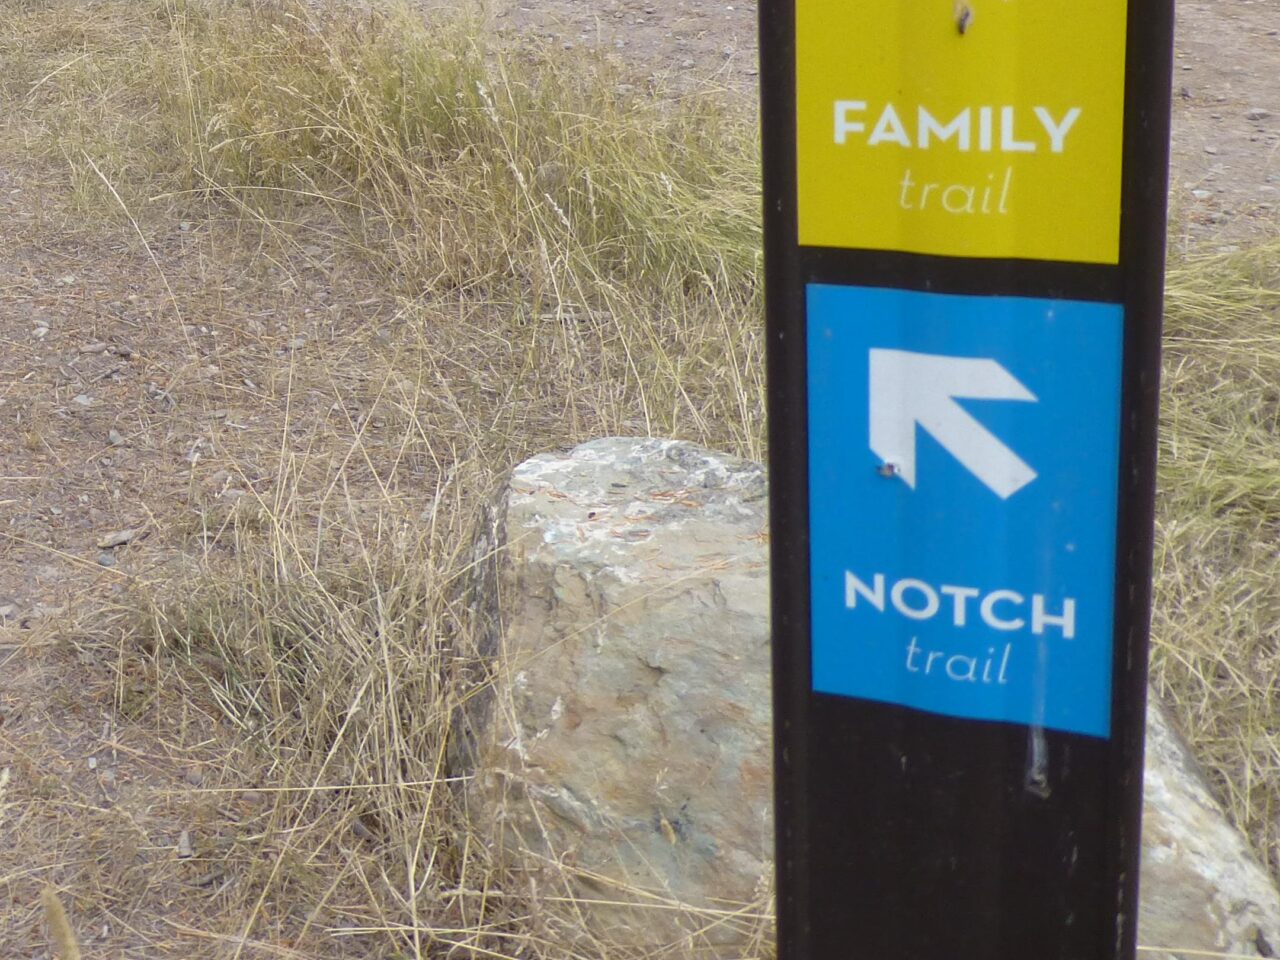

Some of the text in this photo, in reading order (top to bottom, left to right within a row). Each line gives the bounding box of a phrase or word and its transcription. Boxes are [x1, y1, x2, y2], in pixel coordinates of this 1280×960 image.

[833, 100, 1082, 153] FAMILY
[899, 166, 1013, 215] trail
[844, 570, 1076, 639] NOTCH
[905, 636, 1012, 684] trail
